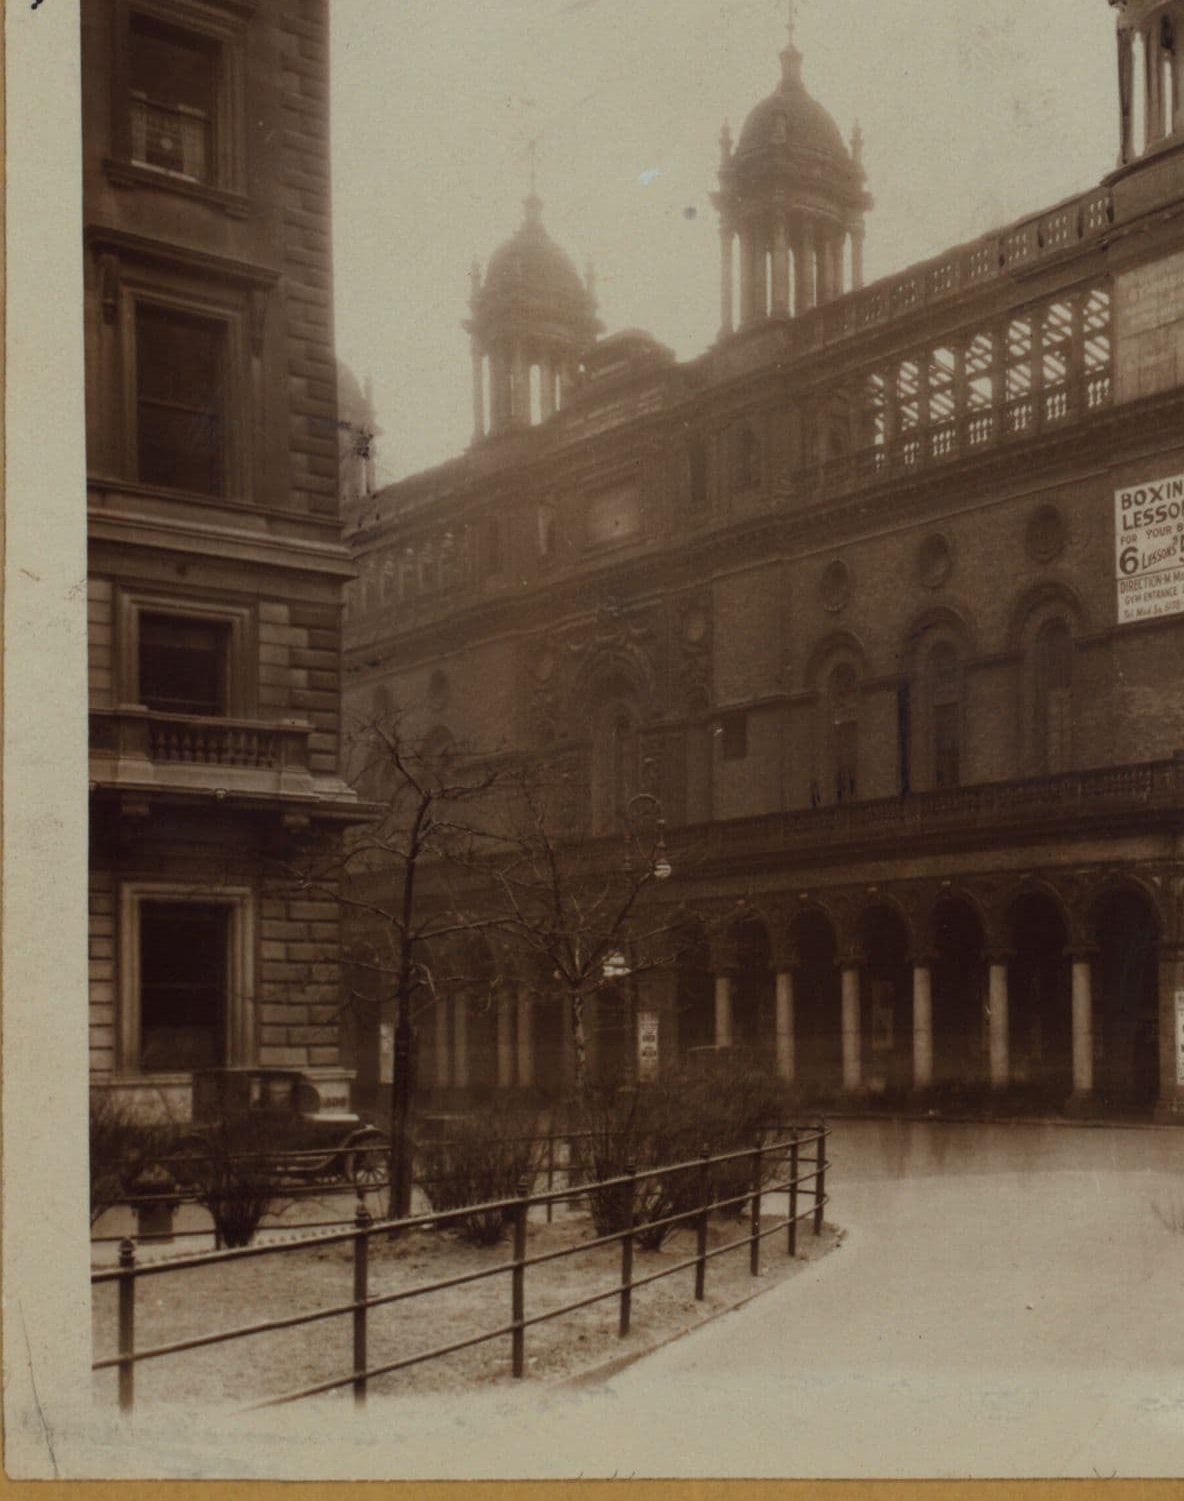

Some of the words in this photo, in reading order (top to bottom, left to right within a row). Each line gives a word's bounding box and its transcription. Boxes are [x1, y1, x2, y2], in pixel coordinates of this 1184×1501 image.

[1120, 533, 1138, 546] FOR
[1146, 525, 1172, 540] YOUR
[1119, 546, 1139, 575] 6
[1124, 594, 1142, 605] GYM
[1143, 586, 1178, 601] ENTRANCE
